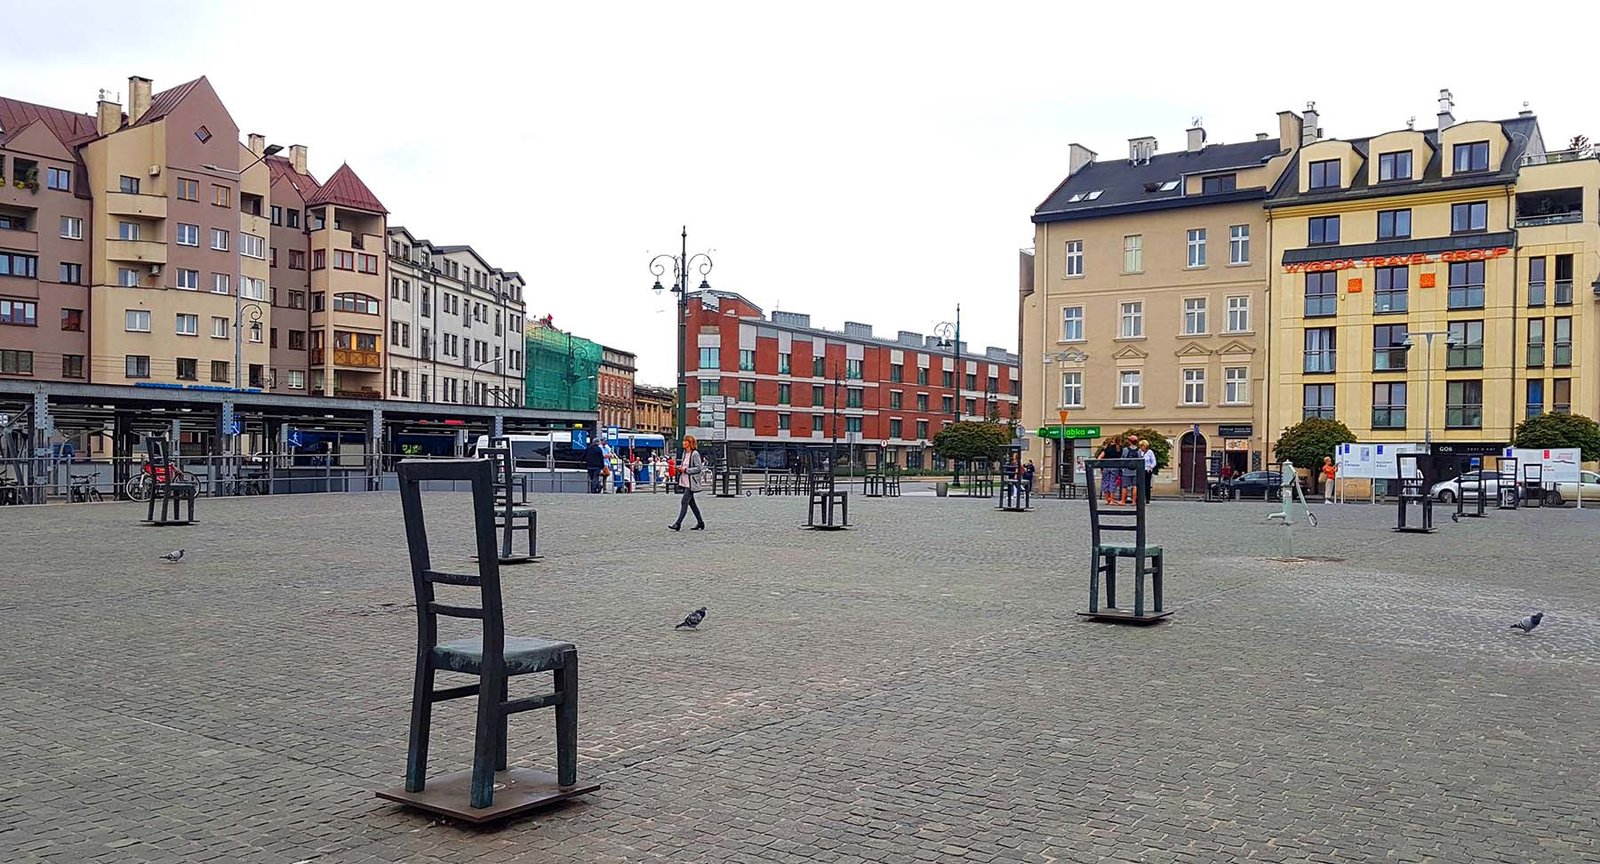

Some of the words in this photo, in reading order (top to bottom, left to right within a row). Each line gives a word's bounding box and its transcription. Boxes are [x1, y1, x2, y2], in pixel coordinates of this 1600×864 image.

[1284, 258, 1357, 273] WYGODA
[1363, 253, 1434, 268] TRAVEL
[1440, 247, 1508, 262] GROUP
